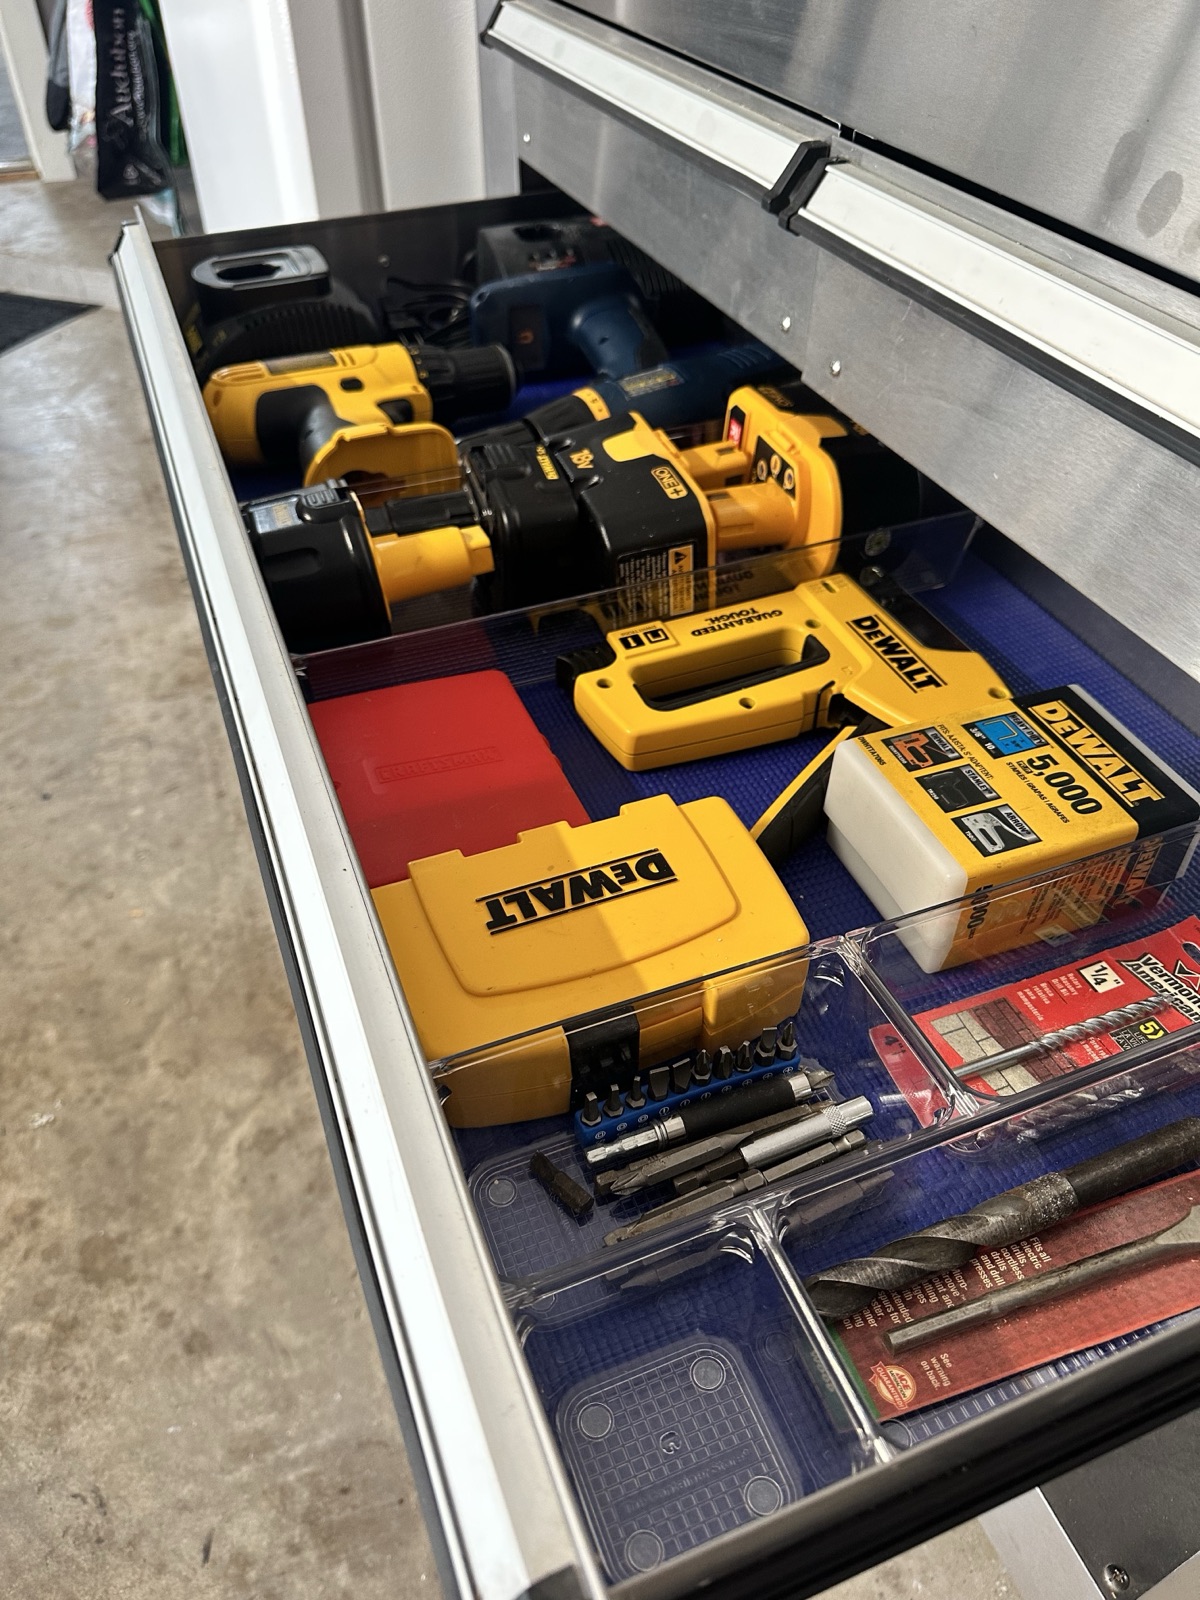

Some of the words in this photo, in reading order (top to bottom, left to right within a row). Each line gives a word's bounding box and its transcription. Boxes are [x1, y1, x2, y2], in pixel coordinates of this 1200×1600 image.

[569, 448, 595, 470] 18V
[690, 609, 784, 637] GUARANTEED
[850, 614, 944, 692] DEWALT
[1010, 714, 1030, 733] HEAVY
[1027, 728, 1046, 745] DUTY
[1029, 700, 1163, 804] DEWALT
[1006, 762, 1027, 782] STAPLES
[1026, 779, 1047, 801] GRAPAS
[1047, 802, 1070, 824] AGRAFES
[1026, 753, 1103, 815] 5,000
[484, 850, 677, 932] DEWALT
[1141, 955, 1200, 1010] Vermon
[990, 1251, 1007, 1272] drills
[1000, 1247, 1025, 1280] cordless
[1020, 1240, 1042, 1270] electric
[1030, 1236, 1043, 1252] Fits
[1039, 1251, 1052, 1263] all
[932, 1276, 947, 1293] oint
[969, 1258, 994, 1289] presses
[980, 1254, 996, 1270] and
[989, 1269, 1006, 1286] drill
[878, 1290, 894, 1313] spurs
[889, 1311, 902, 1324] for
[901, 1289, 913, 1301] ith
[920, 1360, 931, 1371] on
[926, 1370, 941, 1391] back.
[930, 1356, 951, 1387] warning
[940, 1352, 953, 1368] See
[895, 1372, 912, 1391] ACE
